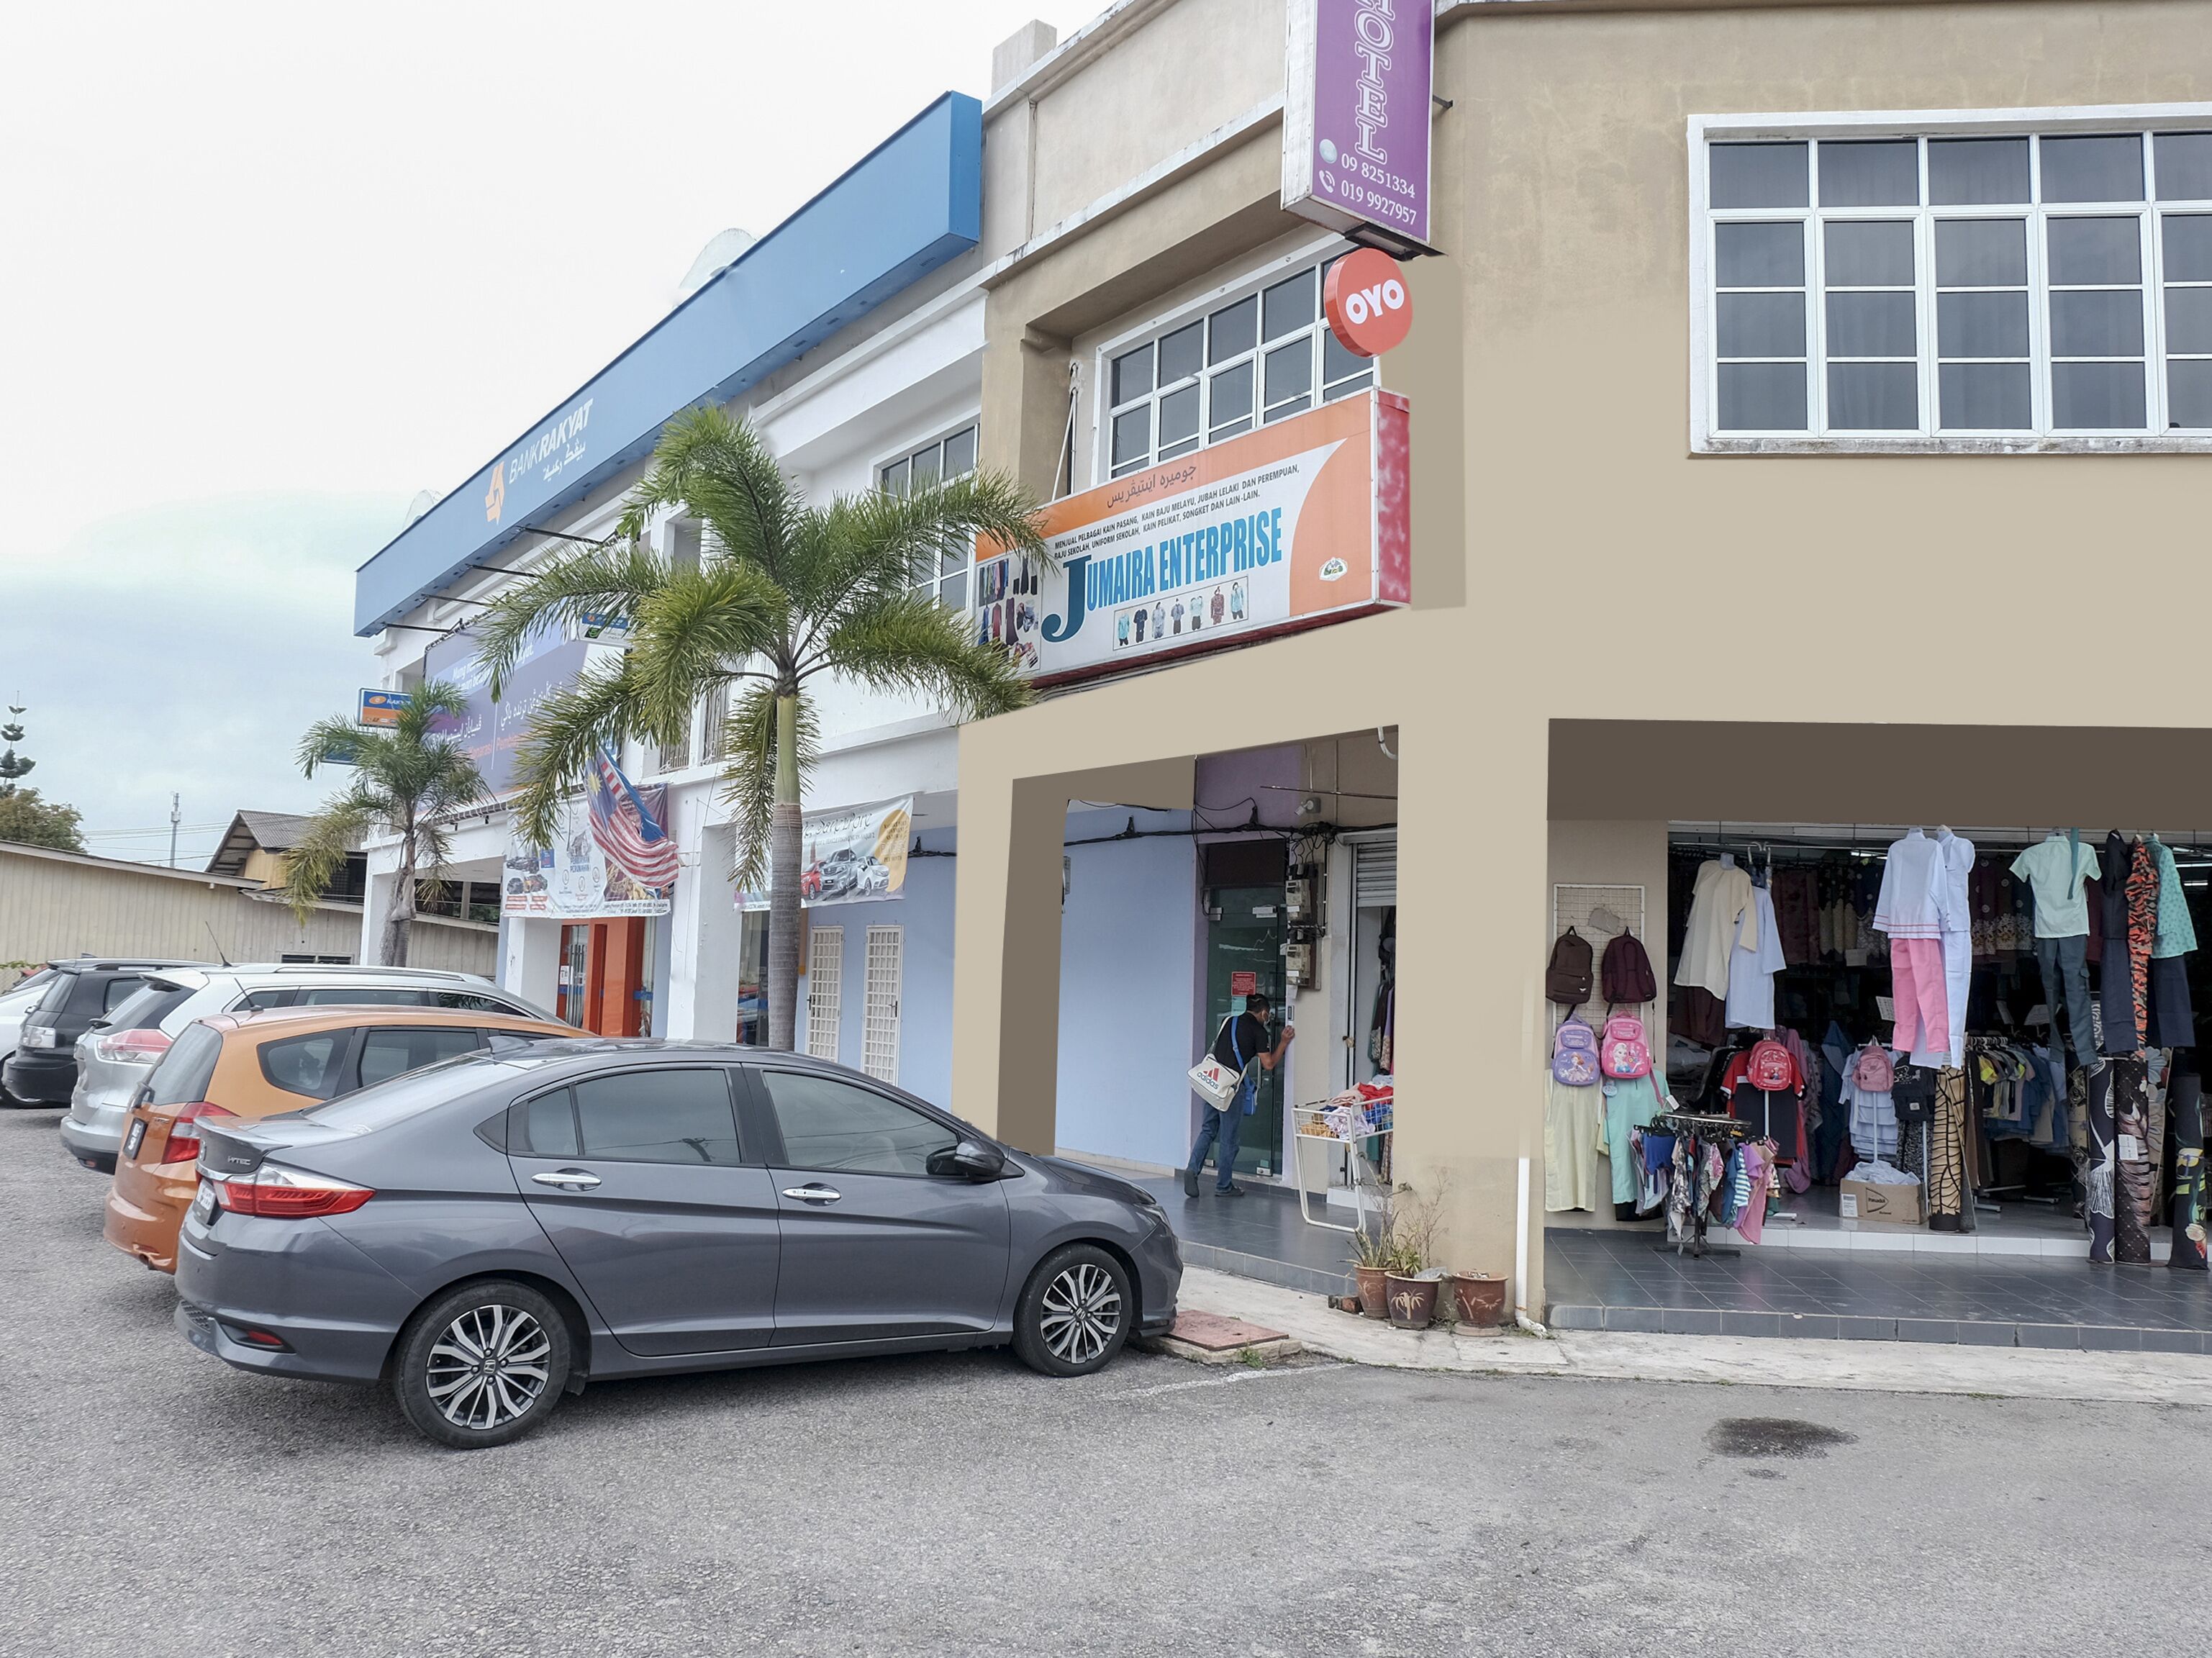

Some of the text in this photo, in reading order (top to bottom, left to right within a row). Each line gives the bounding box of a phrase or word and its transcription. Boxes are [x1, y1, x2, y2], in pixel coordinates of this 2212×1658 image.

[1341, 153, 1416, 199] 09 8251334
[1341, 180, 1417, 225] 019 9927957
[1346, 279, 1405, 325] OYO
[1054, 464, 1300, 549] MENJUAL PELBAGAI KAIN PASANG, KAIN BAJU MELAYU, JUBAH LELAKI DAN PEREMPUAN,
[1092, 534, 1115, 548] UNIFORM
[1143, 521, 1156, 533] KAIN
[1158, 513, 1182, 527] PELIKAT,
[1182, 504, 1210, 520] SONGKET
[1211, 499, 1224, 512] DAN
[1159, 507, 1282, 591] ENTERPRISE
[1197, 1072, 1220, 1090] adidas
